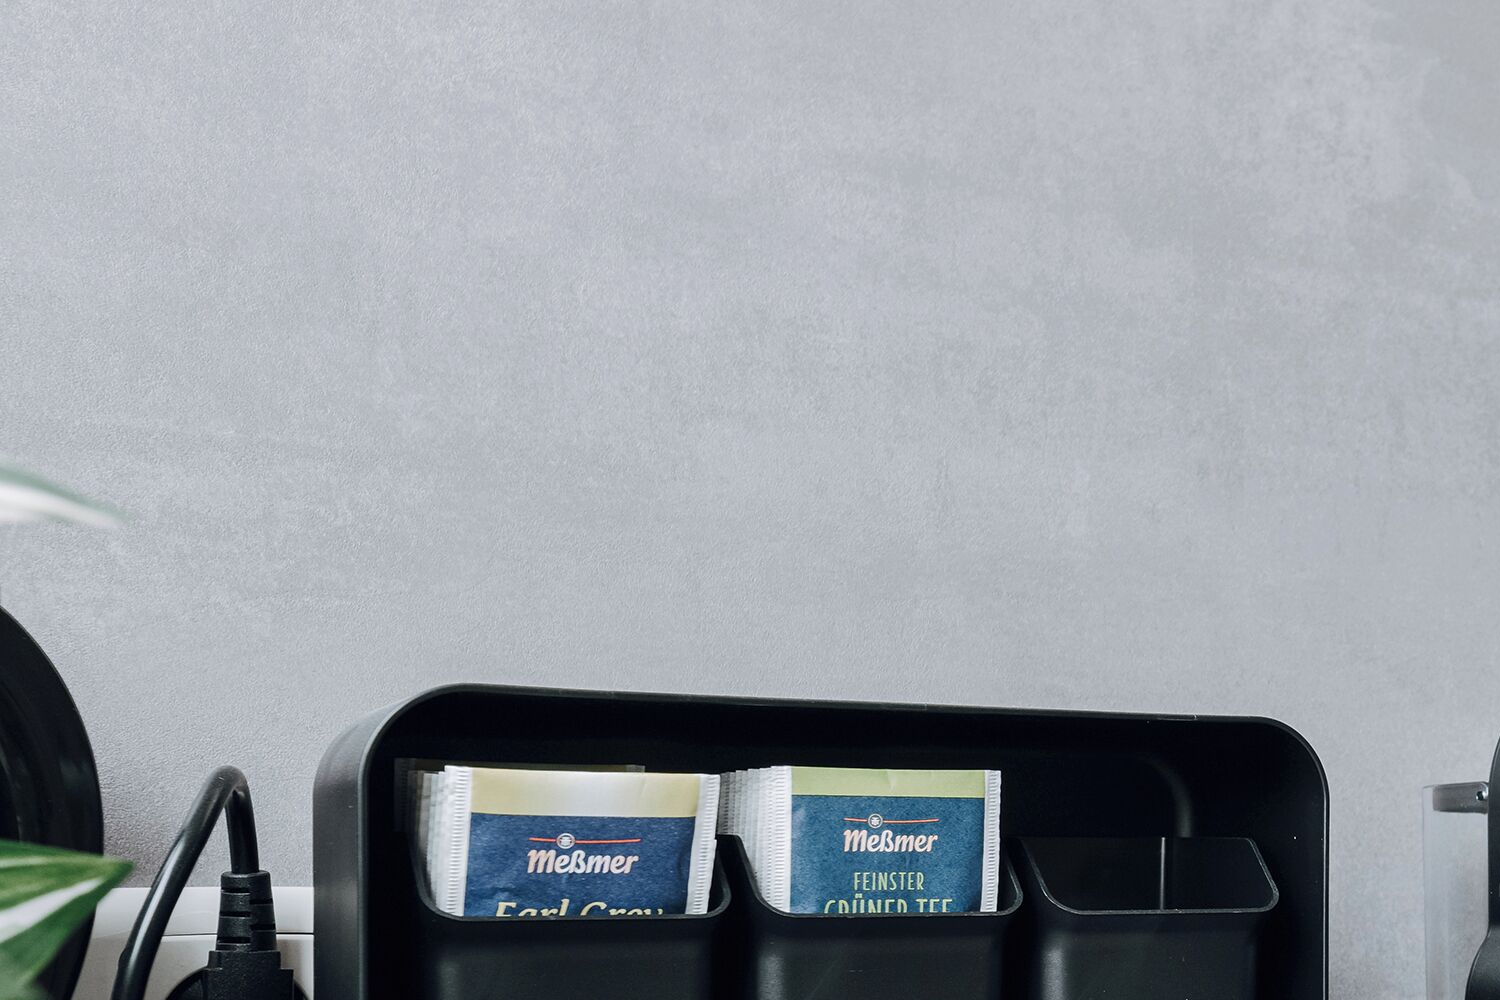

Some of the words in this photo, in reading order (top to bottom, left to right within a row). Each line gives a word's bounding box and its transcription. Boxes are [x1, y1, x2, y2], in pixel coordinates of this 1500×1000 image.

[843, 829, 938, 852] Meßmer
[527, 849, 639, 874] Meßmer
[853, 872, 925, 891] FEINSTER
